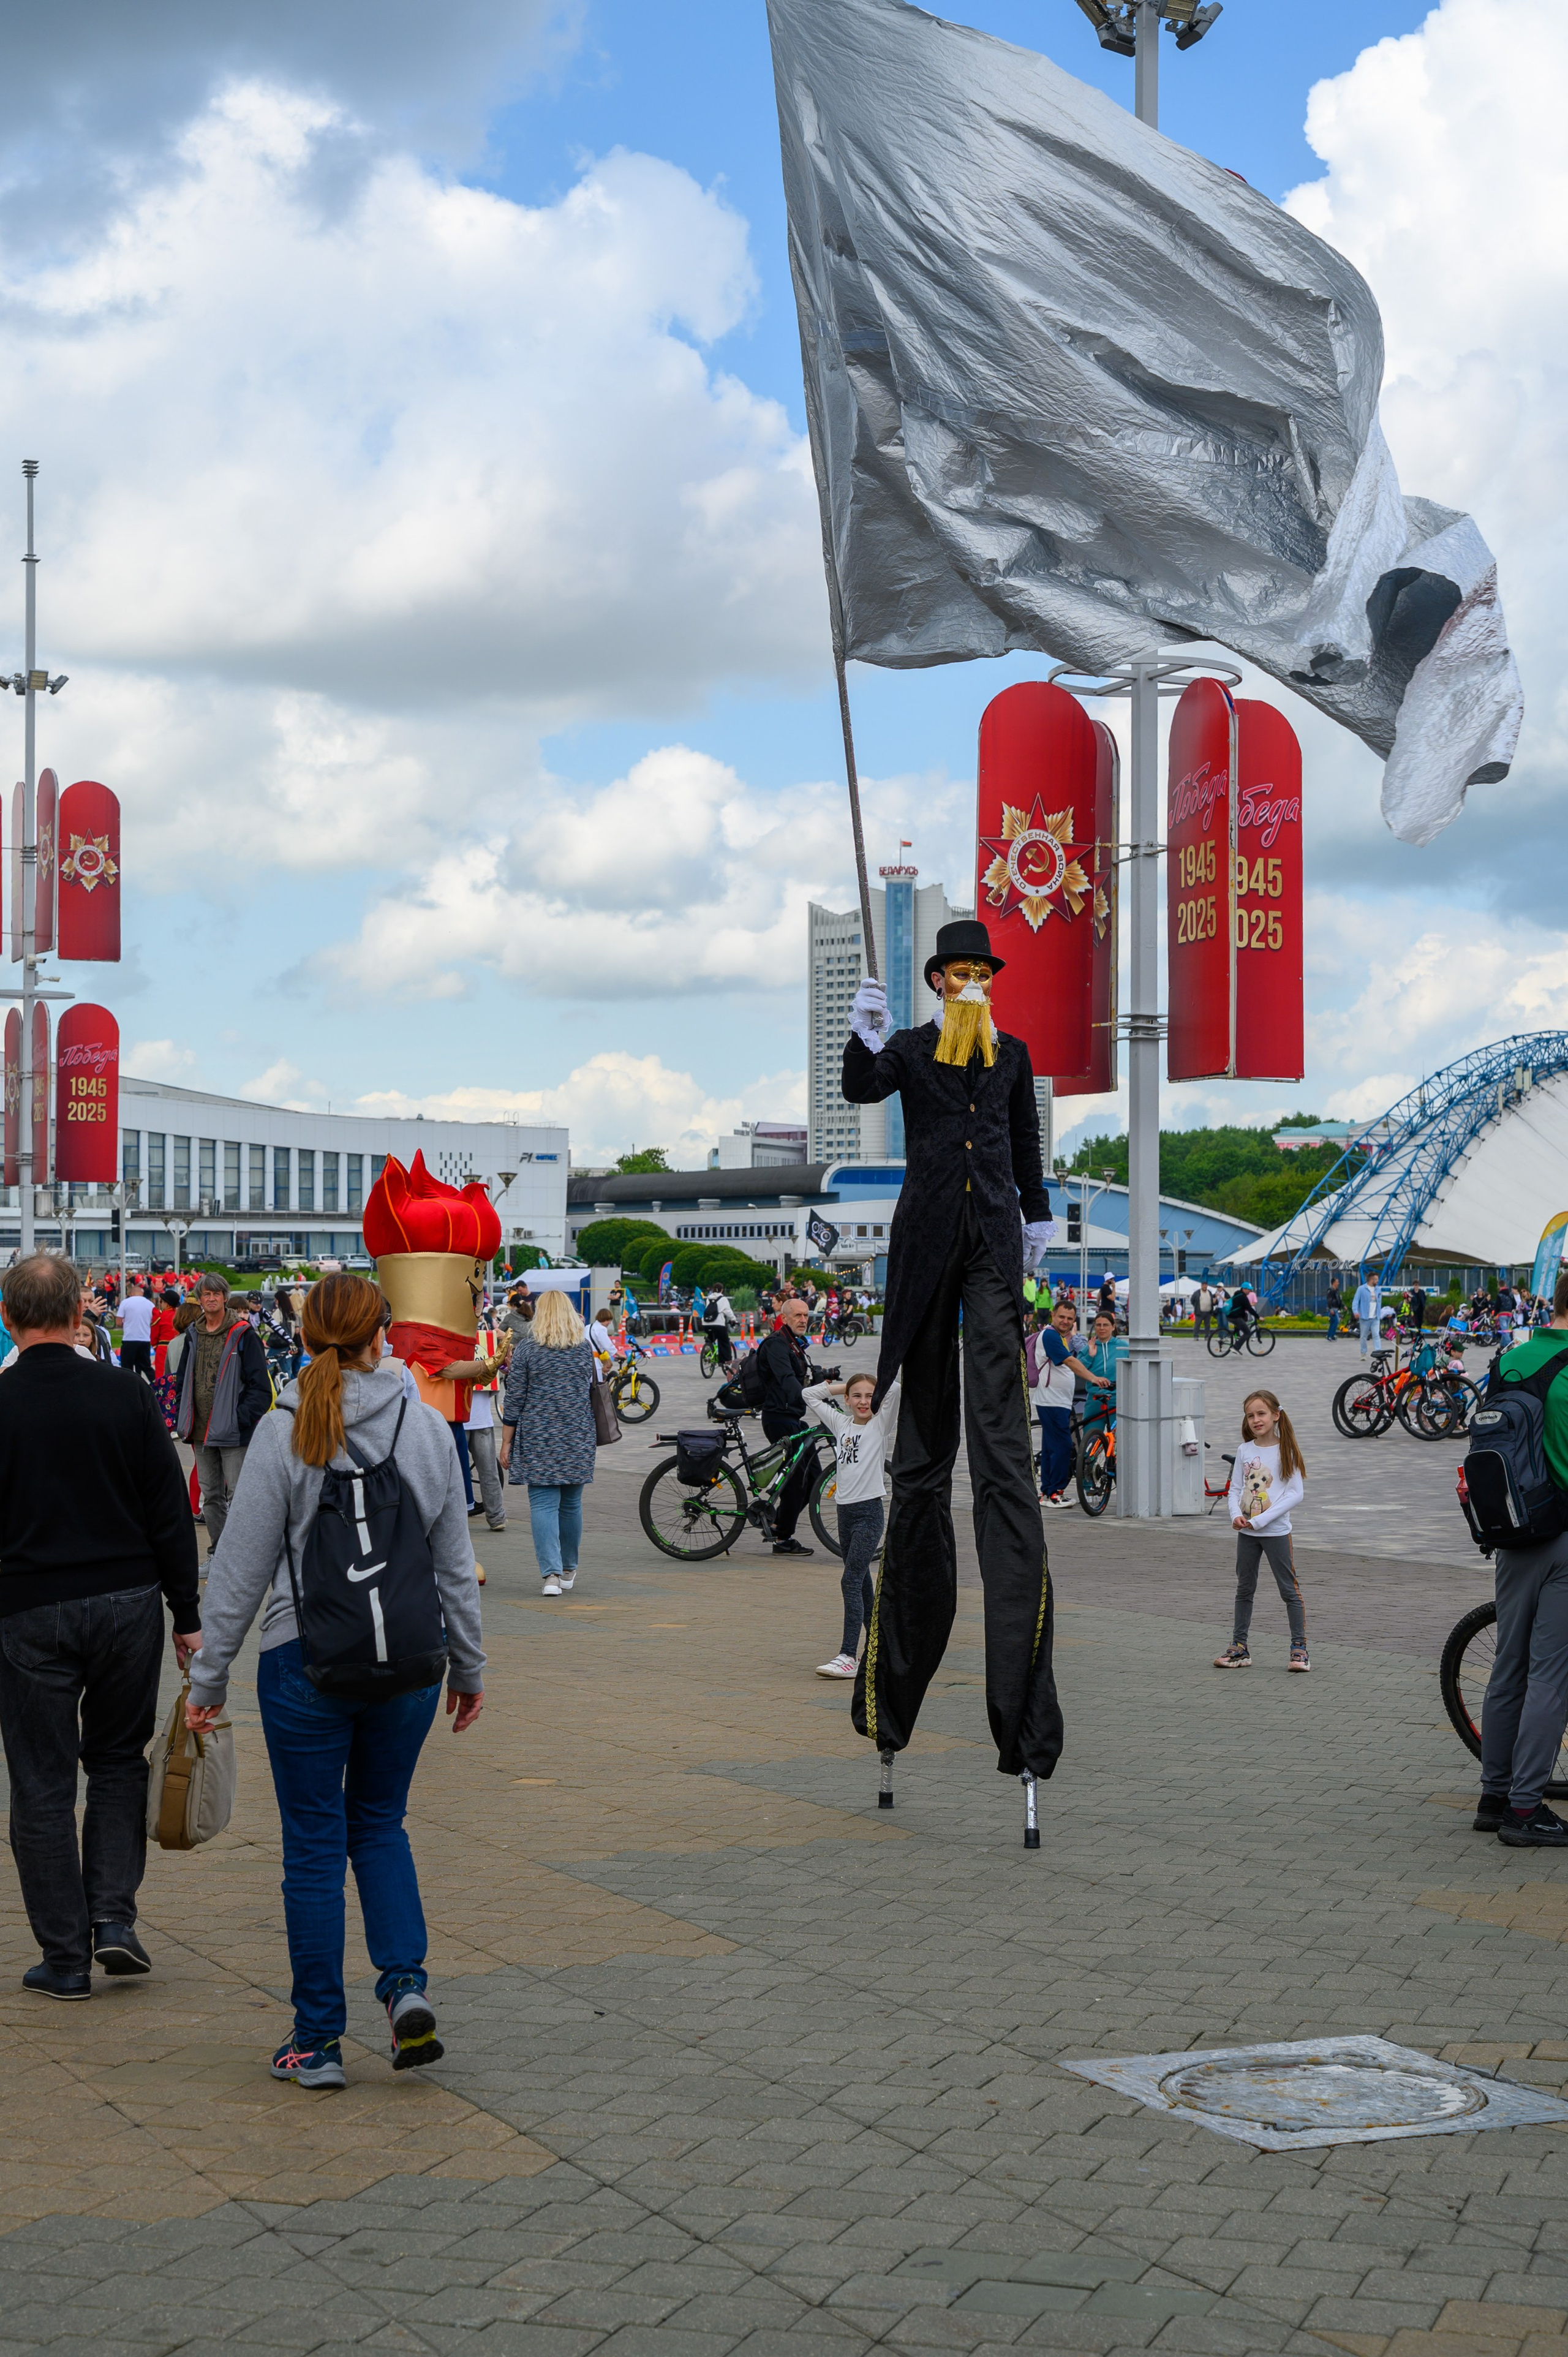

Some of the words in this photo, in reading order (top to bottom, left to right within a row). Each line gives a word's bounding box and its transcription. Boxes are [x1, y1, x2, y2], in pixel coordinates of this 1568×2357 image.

[1169, 761, 1227, 831] Победа
[1237, 783, 1300, 848] беда
[879, 865, 918, 876] БЕЛАРУСЬ
[1011, 832, 1060, 890] ОТЕЧЕСТВЕННАЯ
[1178, 839, 1216, 888] 1945
[1237, 855, 1283, 897] 945
[1177, 896, 1216, 944] 2025
[1237, 908, 1283, 950] 025
[59, 1043, 118, 1074] Победа
[70, 1076, 107, 1097] 1945
[67, 1101, 107, 1122] 2025
[1291, 1258, 1355, 1271] КАТОК
